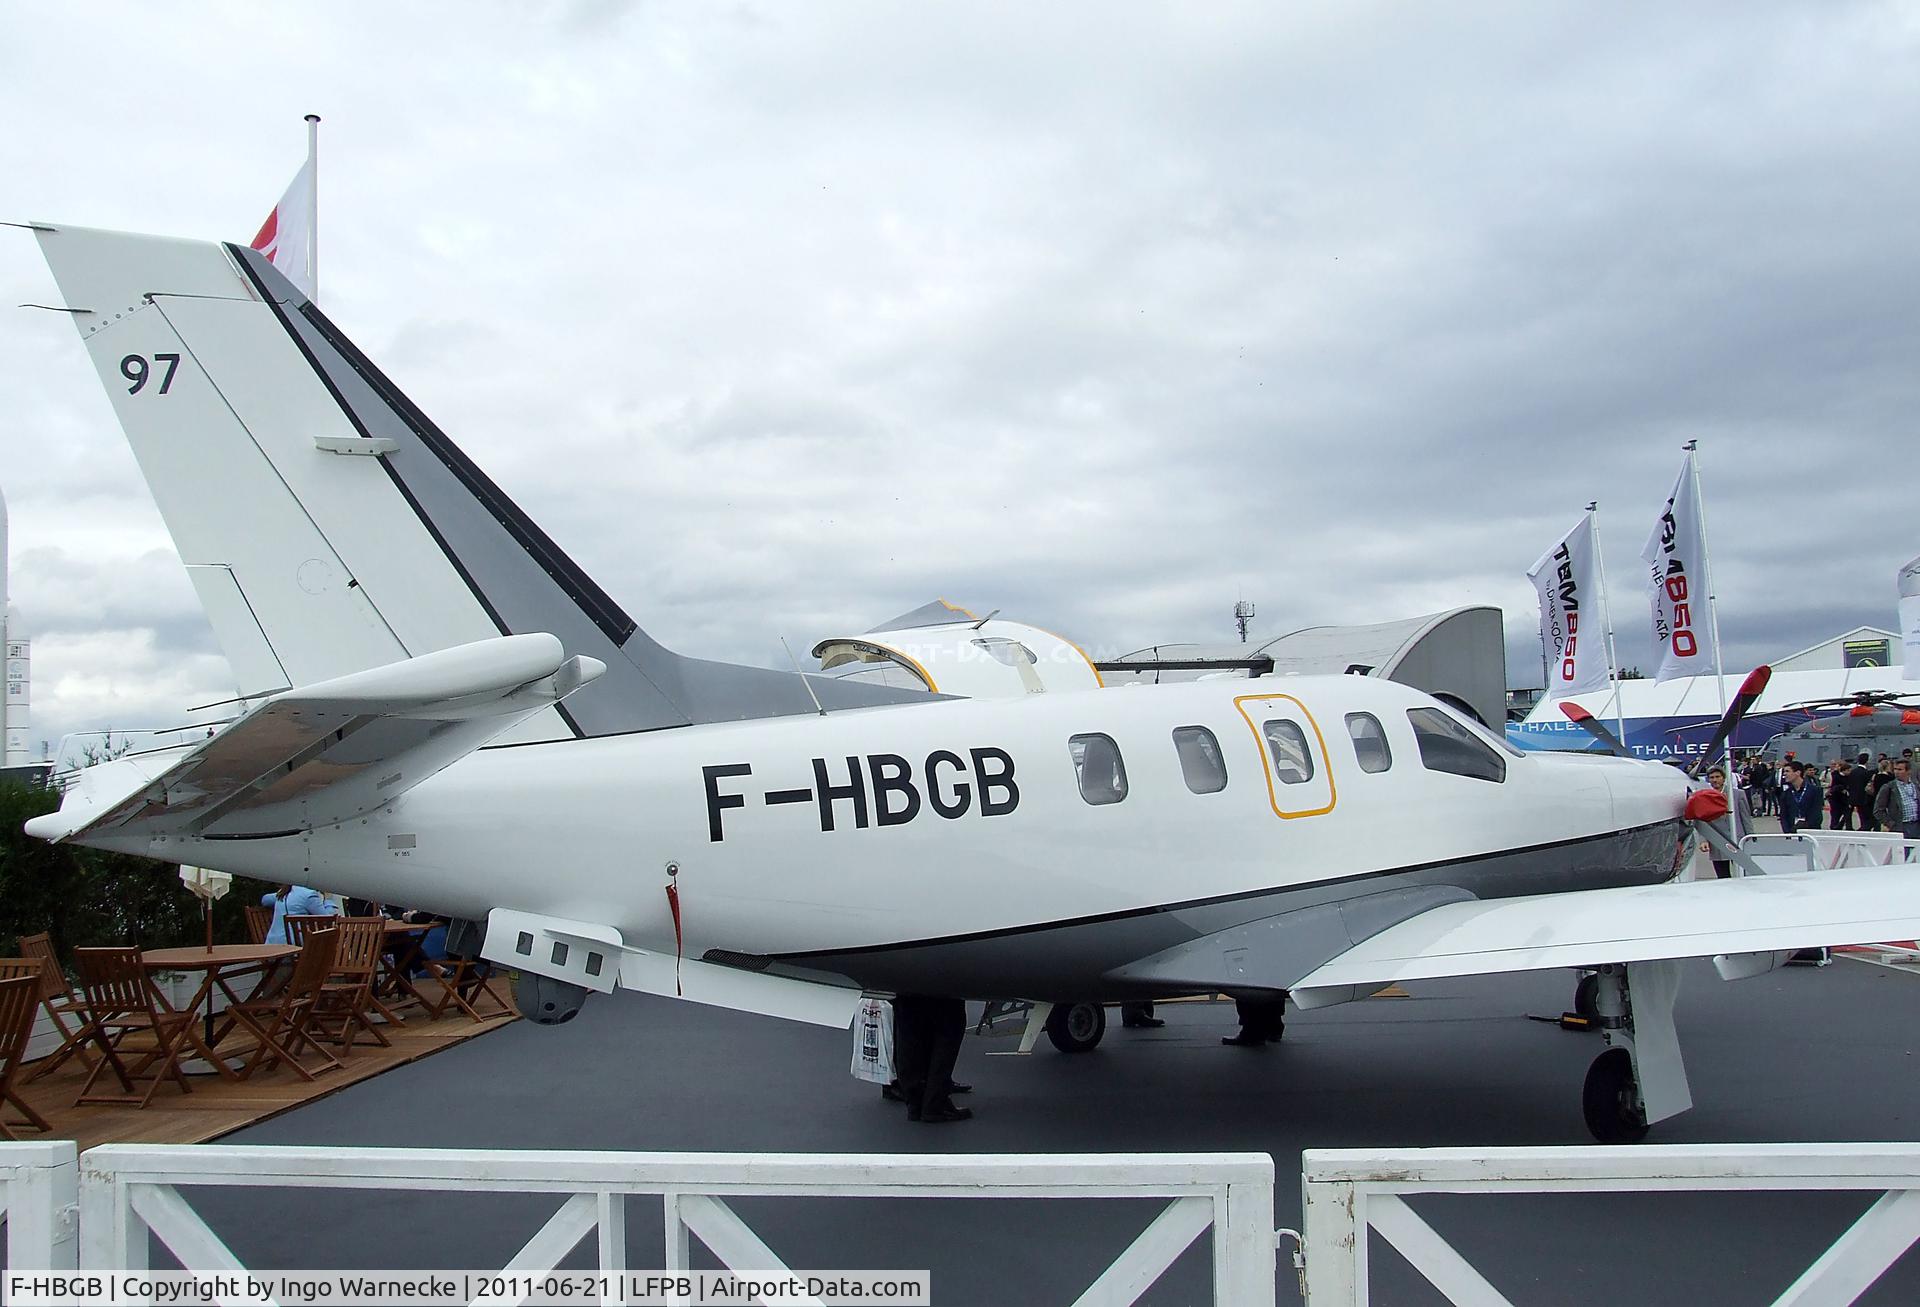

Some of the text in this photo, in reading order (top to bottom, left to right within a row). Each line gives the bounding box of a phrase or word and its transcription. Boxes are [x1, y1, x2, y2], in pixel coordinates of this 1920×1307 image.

[120, 353, 181, 395] 97
[1553, 541, 1580, 682] TBM850
[1631, 743, 1711, 756] THALES
[701, 746, 1021, 843] F-HBGB
